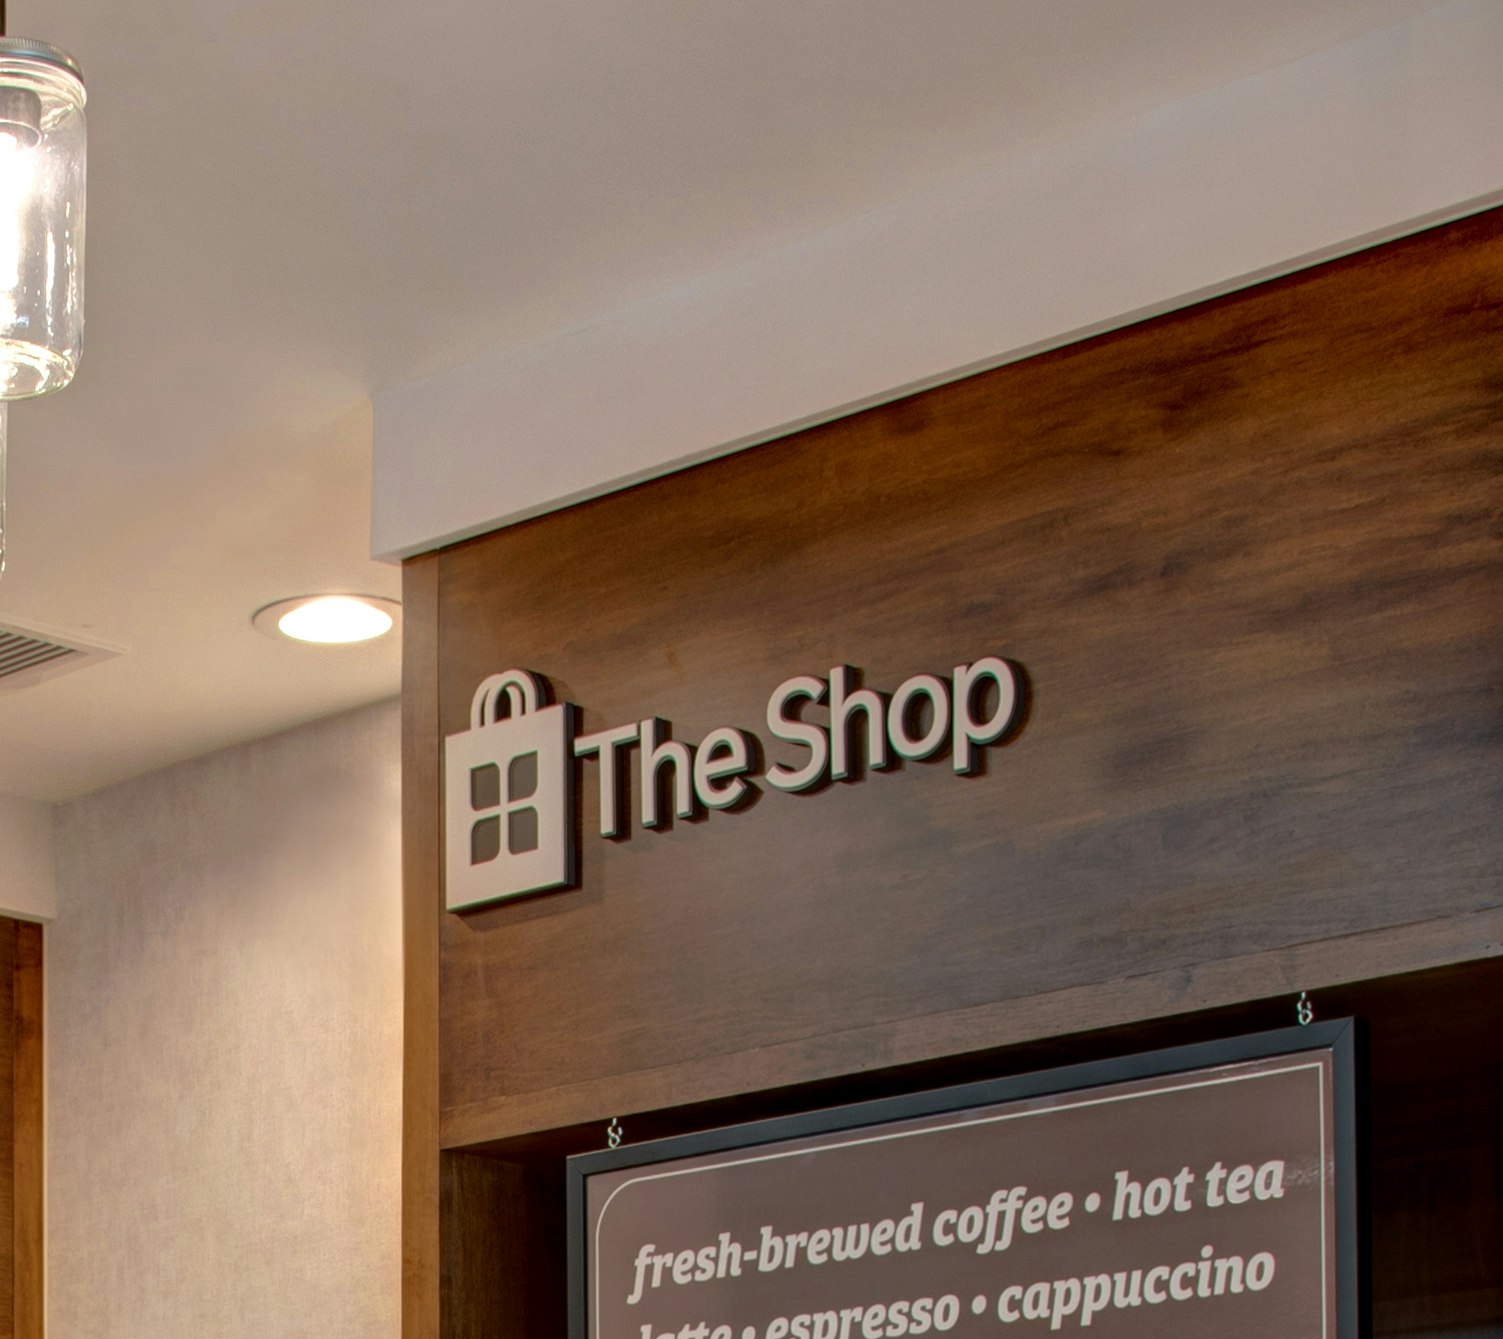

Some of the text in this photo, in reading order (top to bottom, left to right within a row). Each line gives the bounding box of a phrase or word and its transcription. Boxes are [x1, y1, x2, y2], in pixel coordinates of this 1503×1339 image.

[574, 657, 1017, 839] The Shop
[627, 1158, 1285, 1304] fresh-brewed coffee hot tea
[997, 1249, 1275, 1337] cappuccino
